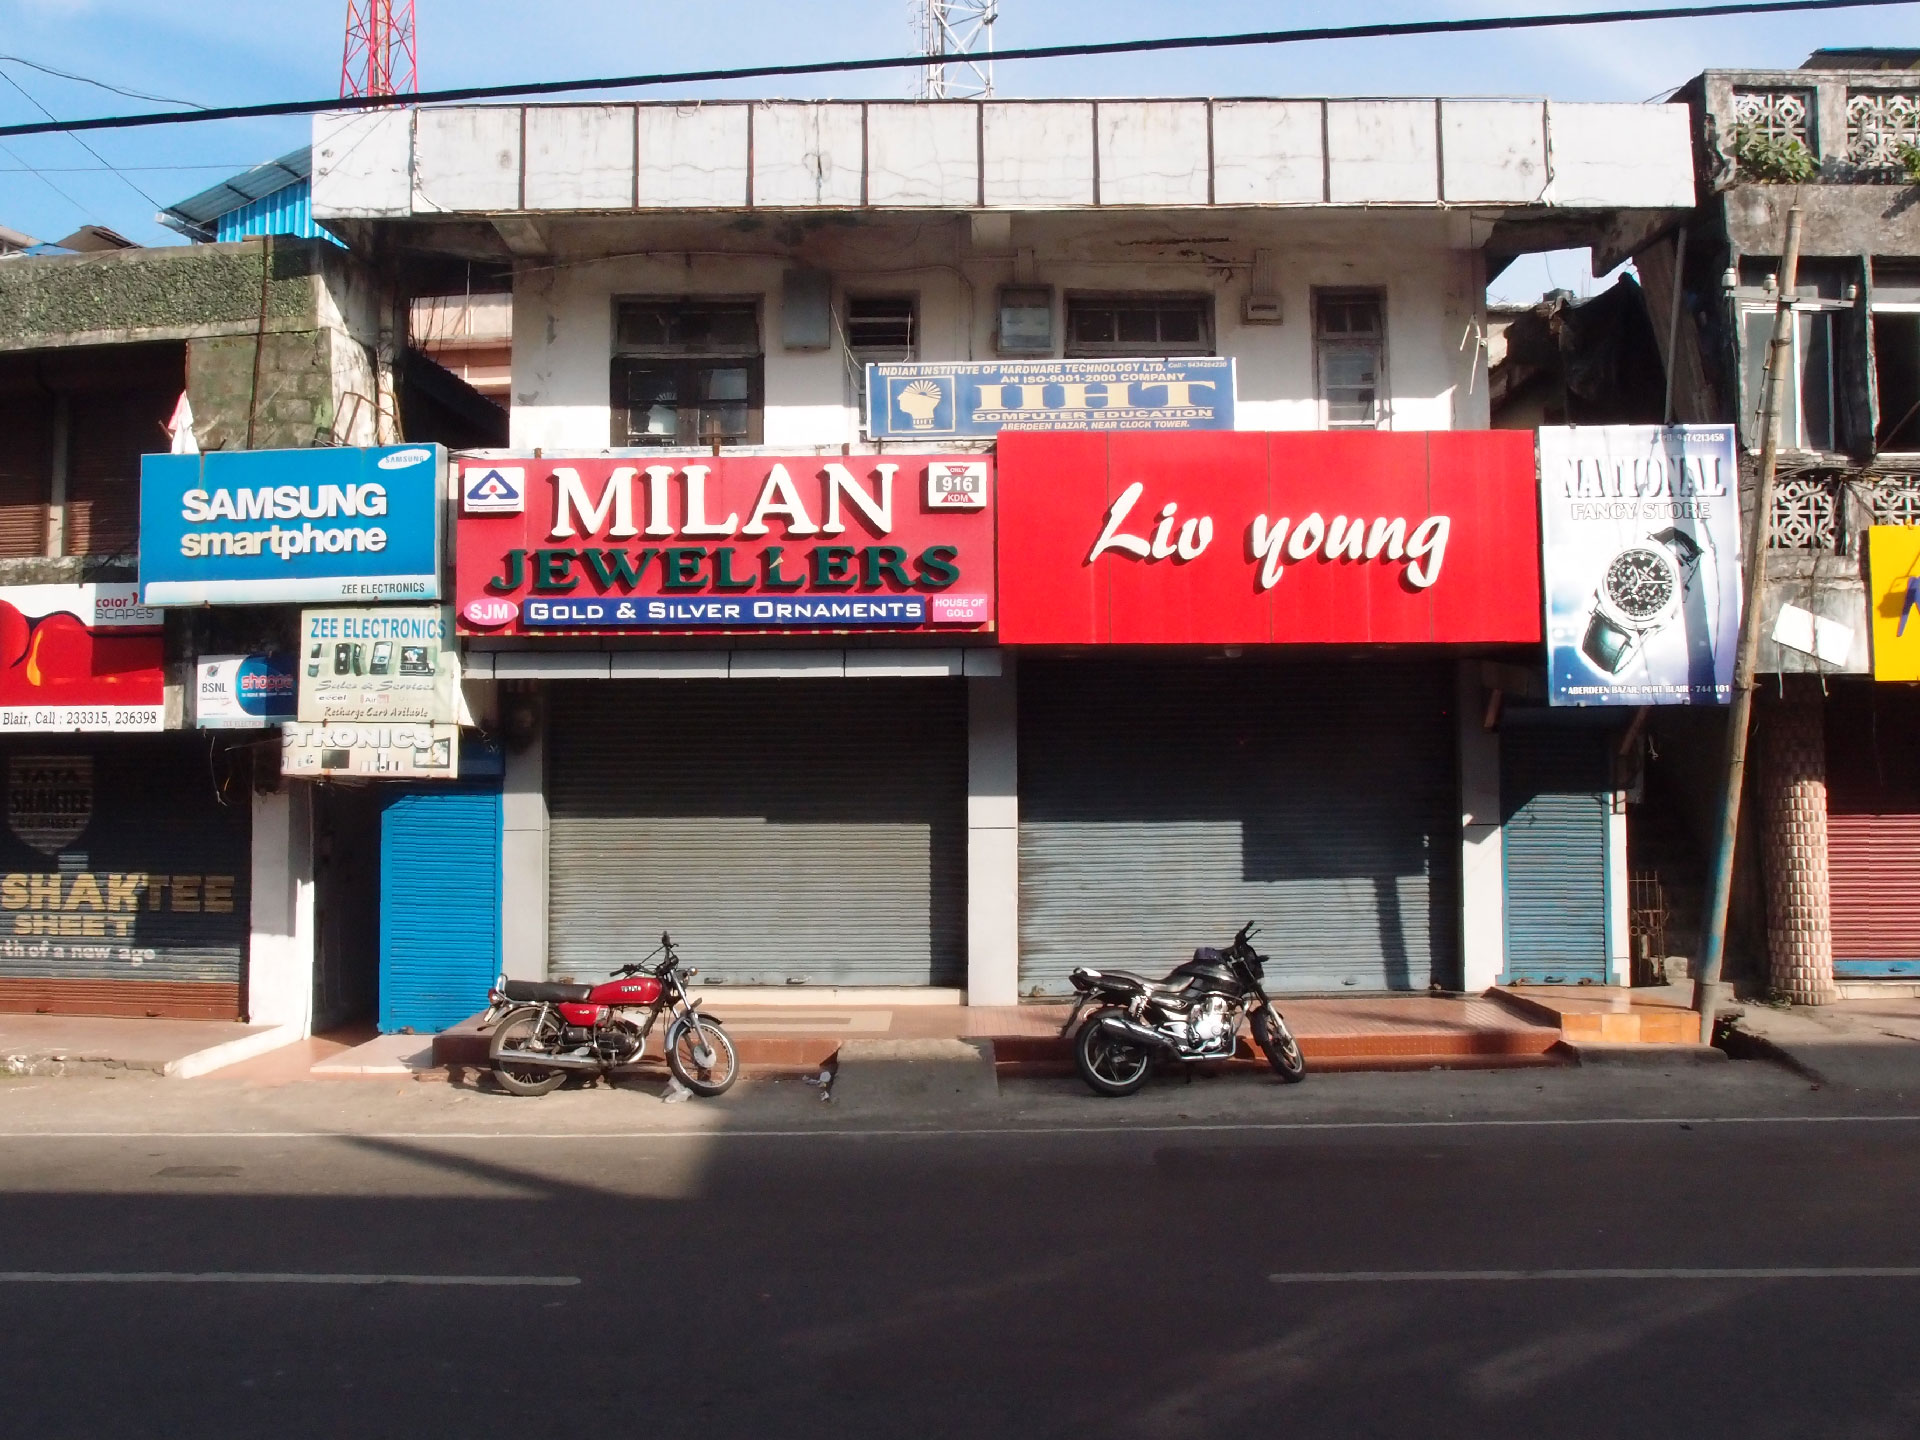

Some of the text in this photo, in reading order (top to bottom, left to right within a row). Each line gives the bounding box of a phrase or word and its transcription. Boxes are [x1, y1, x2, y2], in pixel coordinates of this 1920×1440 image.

[878, 362, 1166, 376] INDIAN INSTITUTE OF HARDWARE TECHNOLOGY LTD.
[1023, 374, 1116, 383] ISO-9001-2000
[1120, 373, 1186, 381] COMPANY
[973, 382, 1216, 410] IIHT
[972, 409, 1213, 421] COMPUTER EDUCATION
[1000, 420, 1190, 431] ABERDEEN BAZAR, NEAR CLOCK TOWER.
[384, 455, 424, 464] SAMSUNG
[942, 476, 973, 492] 916
[1560, 455, 1727, 498] NATIONAL
[180, 482, 387, 522] SAMSUNG
[549, 463, 900, 538] MILAN
[947, 494, 969, 503] KDM
[1570, 501, 1712, 520] FANCY STORE
[180, 522, 387, 560] smartphone
[1252, 512, 1451, 589] young
[488, 545, 961, 591] JEWELLERS
[341, 582, 425, 594] ZEE ELECTRONICS
[95, 597, 129, 608] color
[935, 598, 985, 607] HOUSE OF
[95, 608, 154, 619] SCAPES
[469, 603, 508, 620] SJM
[530, 601, 922, 620] GOLD & SILVER ORNAMENTS
[946, 608, 974, 617] GOLD
[311, 617, 446, 639] ZEE ELECTRONICS
[202, 682, 228, 693] BSNL
[314, 680, 358, 692] Sales
[1567, 685, 1610, 695] ABERDEEN
[1611, 685, 1640, 695] BAZAR,
[1642, 684, 1663, 694] PORT
[1665, 684, 1689, 694] BLAIR
[1695, 685, 1711, 693] 744
[2, 712, 31, 726] Blair,
[35, 711, 55, 725] Call
[66, 711, 111, 726] 233315,
[115, 711, 157, 724] 236398
[1, 873, 235, 912] SHAKTEE
[13, 914, 136, 936] SHEET
[28, 941, 49, 958] of
[53, 946, 64, 958] a
[71, 946, 111, 959] new
[118, 948, 156, 967] age
